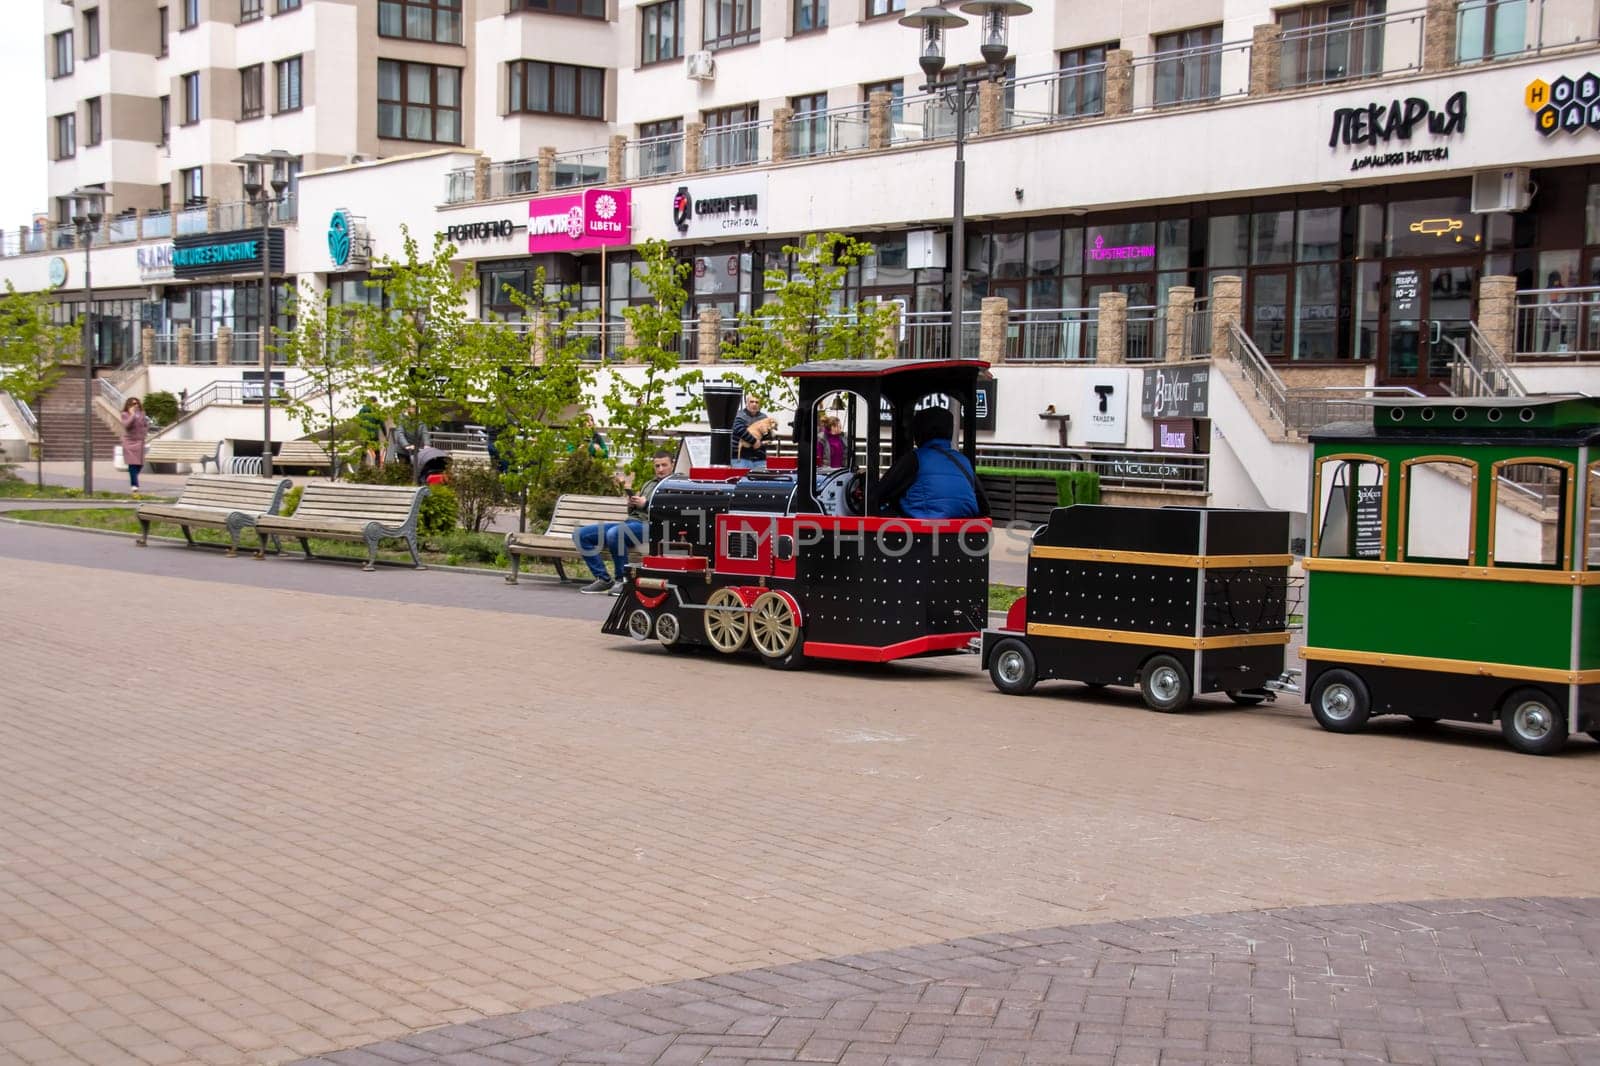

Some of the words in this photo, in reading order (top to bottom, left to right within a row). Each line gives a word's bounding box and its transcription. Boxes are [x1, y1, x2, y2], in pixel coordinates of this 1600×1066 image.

[590, 220, 622, 232] ЦВЕТЫ
[722, 219, 758, 229] СТРИТ-ФУД
[447, 219, 513, 242] PORTOFINO
[1093, 415, 1115, 423] ТАНДЕМ
